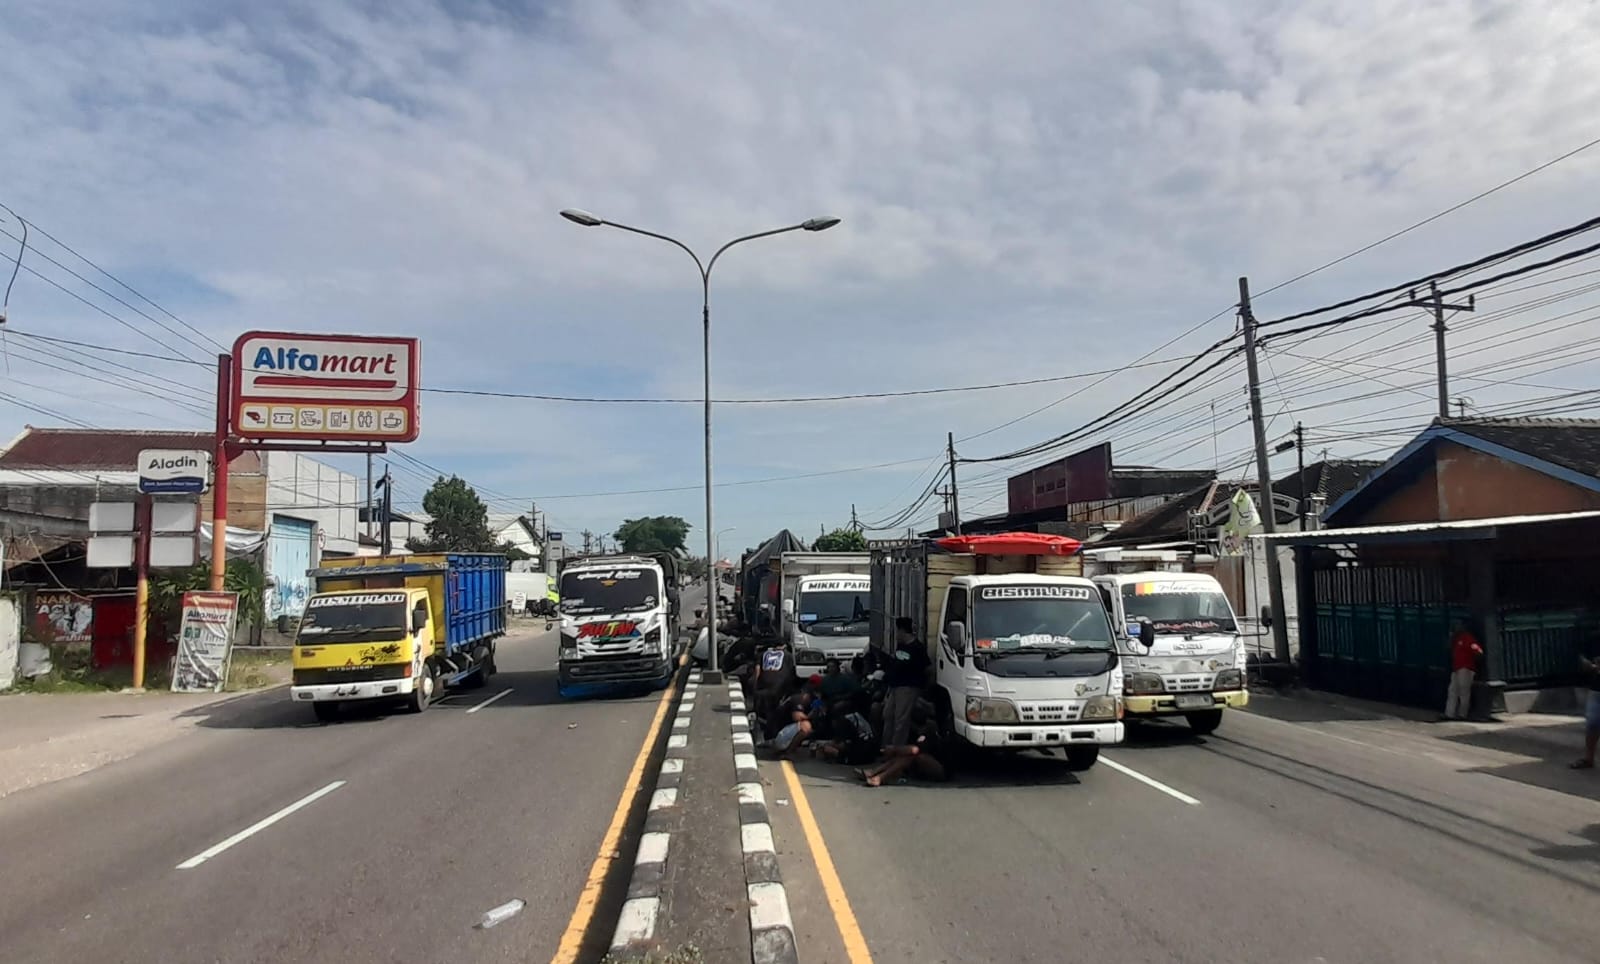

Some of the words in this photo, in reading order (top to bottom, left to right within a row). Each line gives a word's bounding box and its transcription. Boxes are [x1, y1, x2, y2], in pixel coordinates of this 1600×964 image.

[254, 346, 397, 374] Alfamart
[148, 455, 198, 469] Aladin
[982, 587, 1089, 599] BISMILLAH
